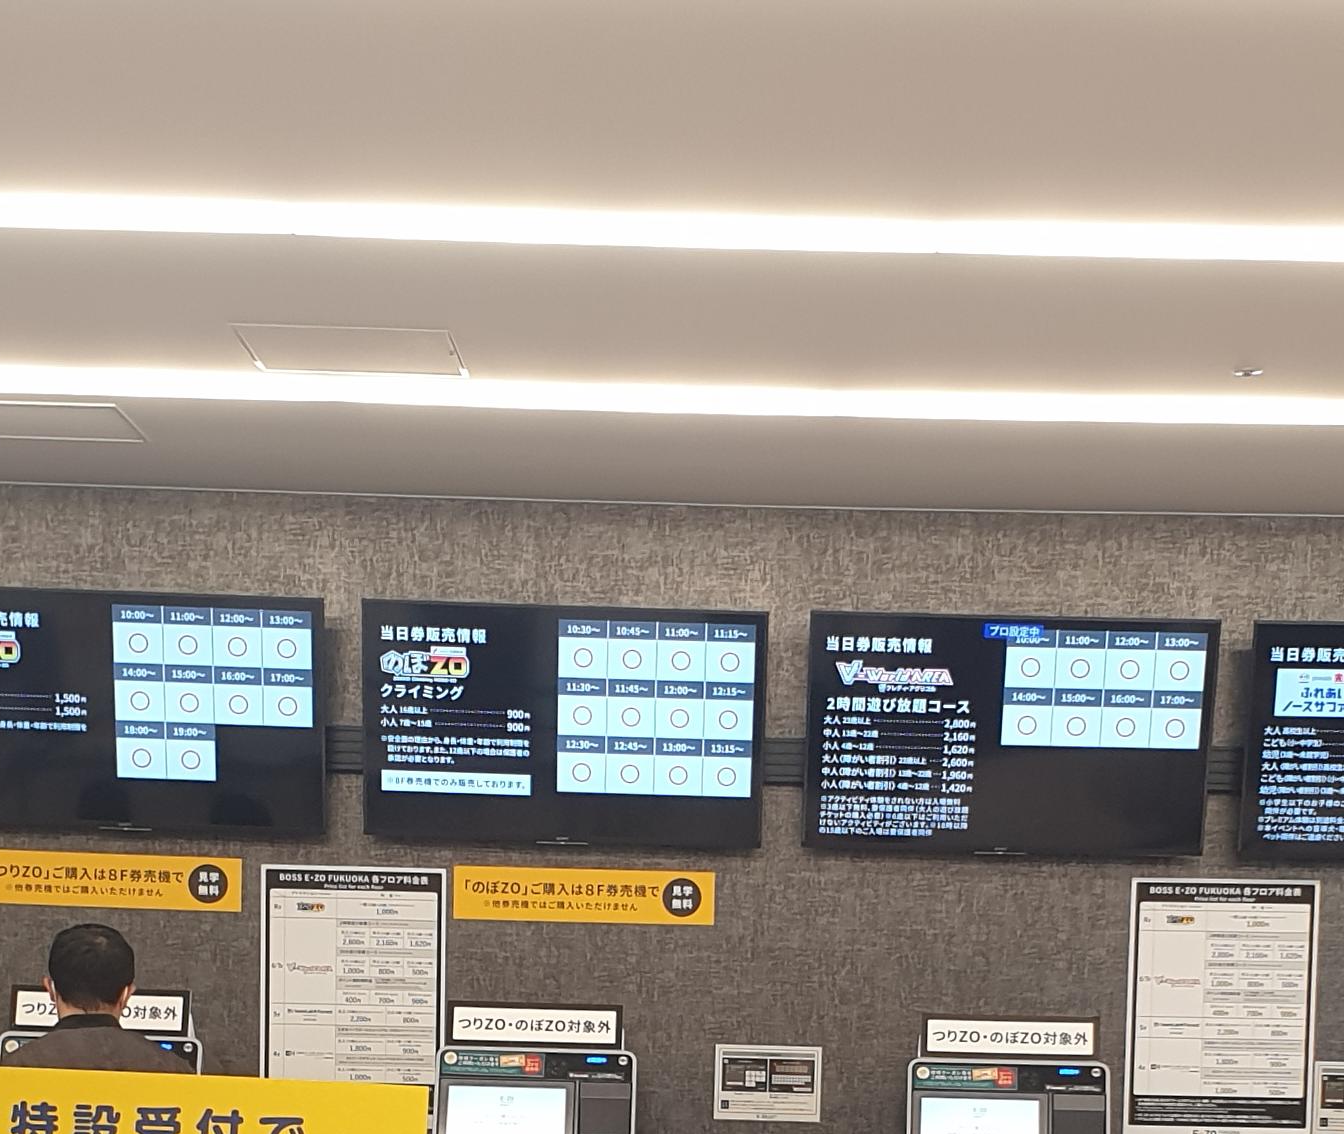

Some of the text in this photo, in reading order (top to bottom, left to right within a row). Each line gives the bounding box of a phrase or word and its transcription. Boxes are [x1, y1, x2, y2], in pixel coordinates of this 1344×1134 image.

[381, 626, 486, 643] 当日券販売情報
[381, 684, 464, 700] クライミング
[826, 698, 970, 714] 2時間遊び放題コース
[328, 875, 369, 883] FUKUOKA
[464, 878, 659, 898] 「のぼZO」ご購入は8F券売機で
[459, 1018, 611, 1033] つりZO・のぼZO対象外
[933, 1030, 1088, 1046] つりZO・のぼZO対象外
